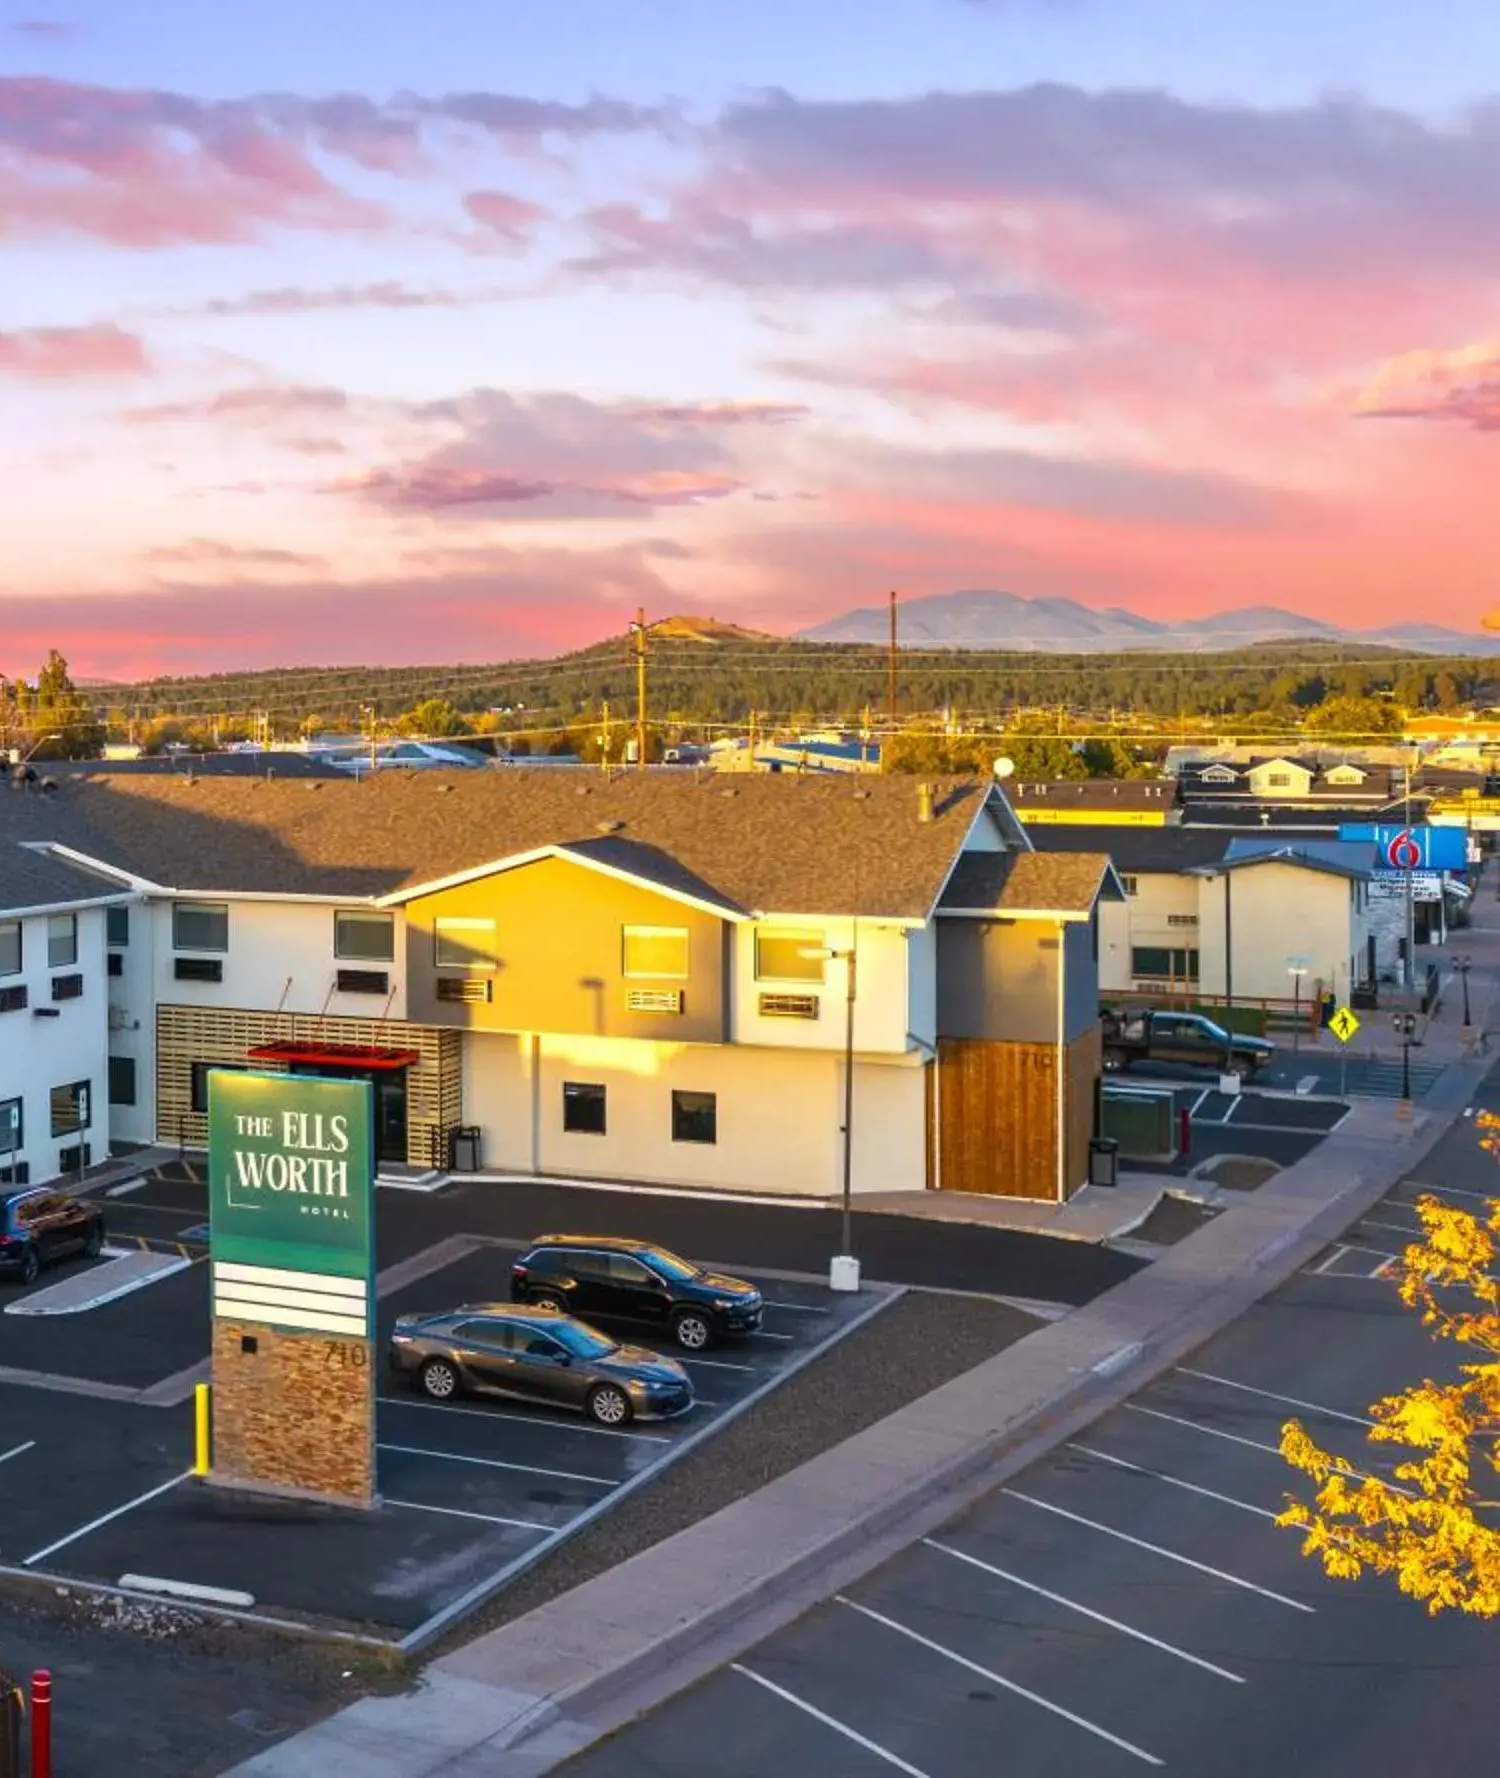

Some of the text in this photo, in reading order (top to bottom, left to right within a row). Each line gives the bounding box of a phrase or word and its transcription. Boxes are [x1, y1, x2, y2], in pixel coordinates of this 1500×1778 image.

[1387, 828, 1421, 868] 6
[234, 1111, 348, 1153] THE ELLS
[235, 1151, 349, 1198] WORTH
[300, 1206, 349, 1219] HOTEL
